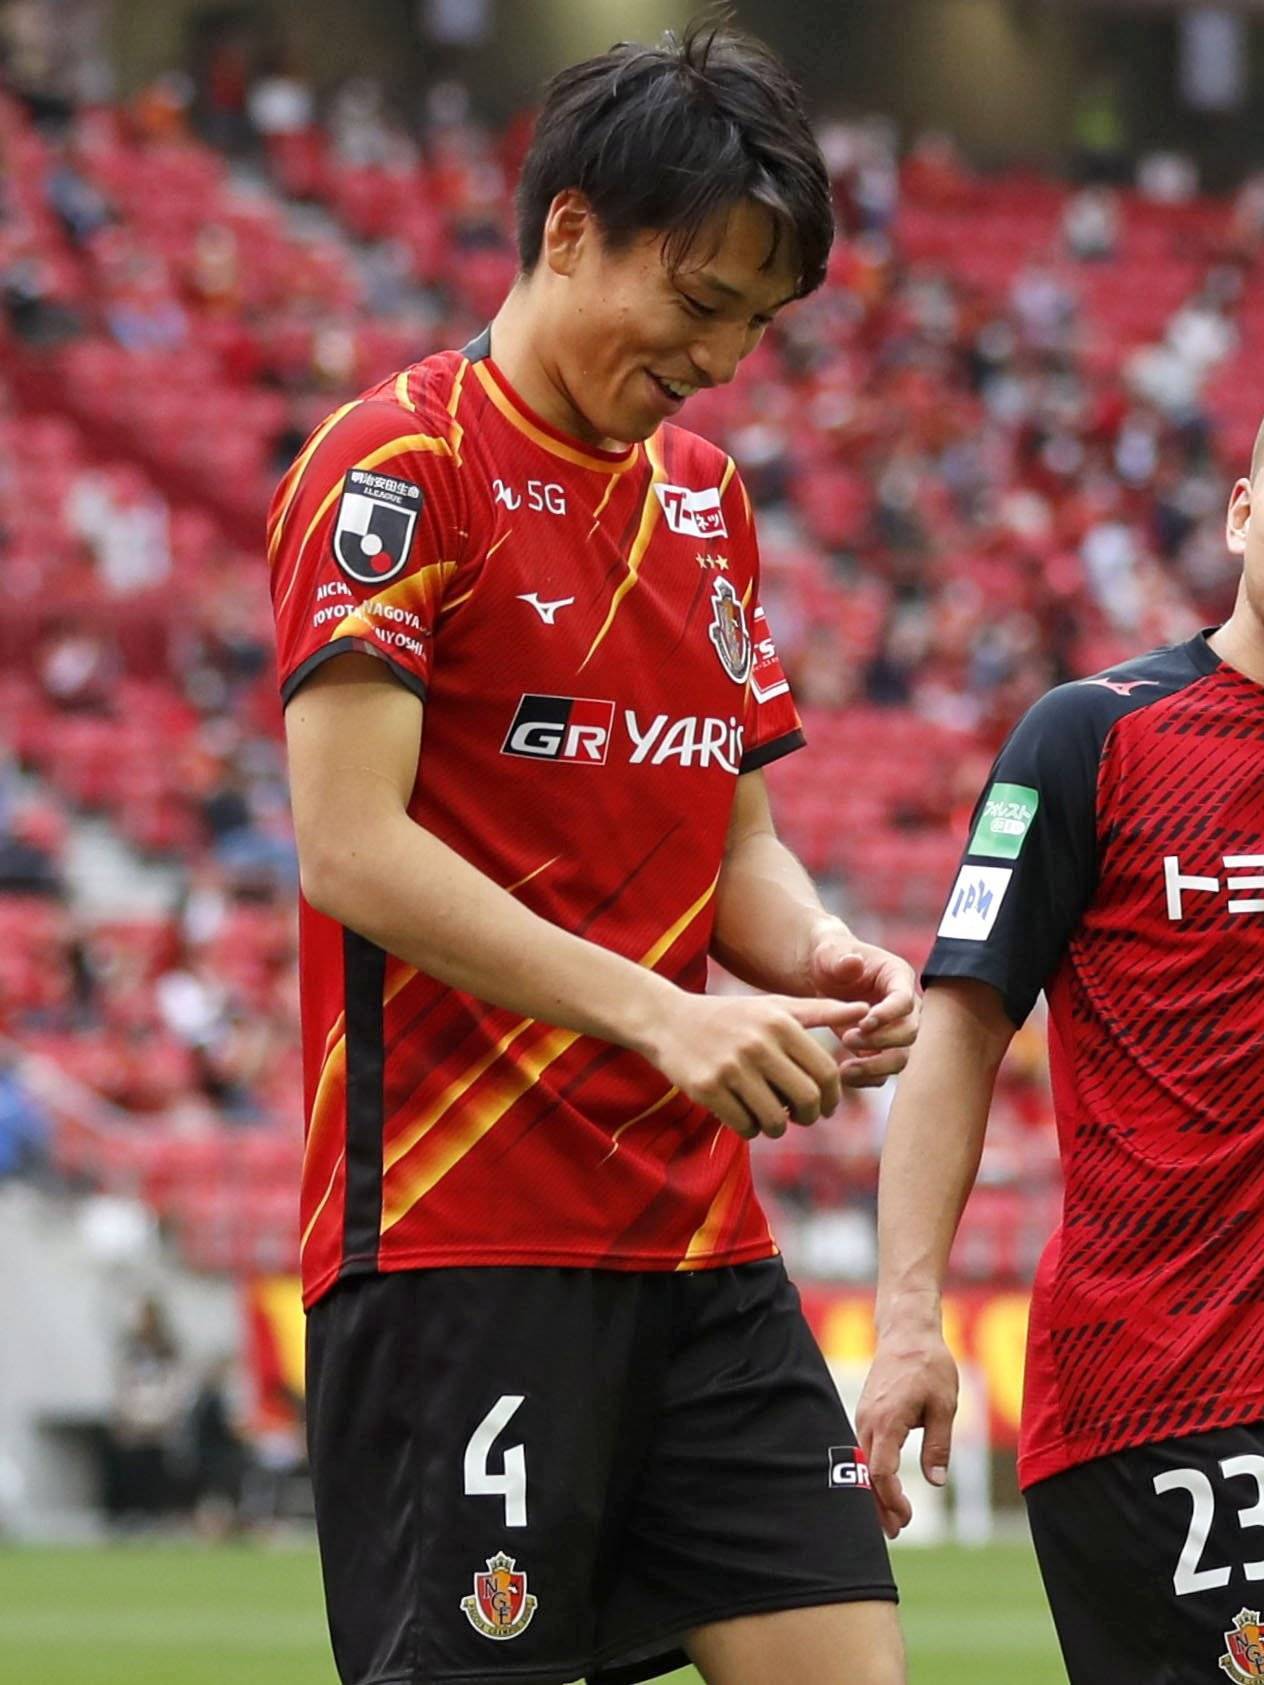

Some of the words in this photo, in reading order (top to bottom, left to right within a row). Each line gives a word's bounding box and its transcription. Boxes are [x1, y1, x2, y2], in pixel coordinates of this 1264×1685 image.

[528, 480, 566, 515] 5G
[316, 581, 352, 602] AICH
[363, 600, 420, 629] NAGOYA
[510, 722, 607, 760] GR
[464, 1395, 527, 1527] 4
[832, 1462, 871, 1486] GR
